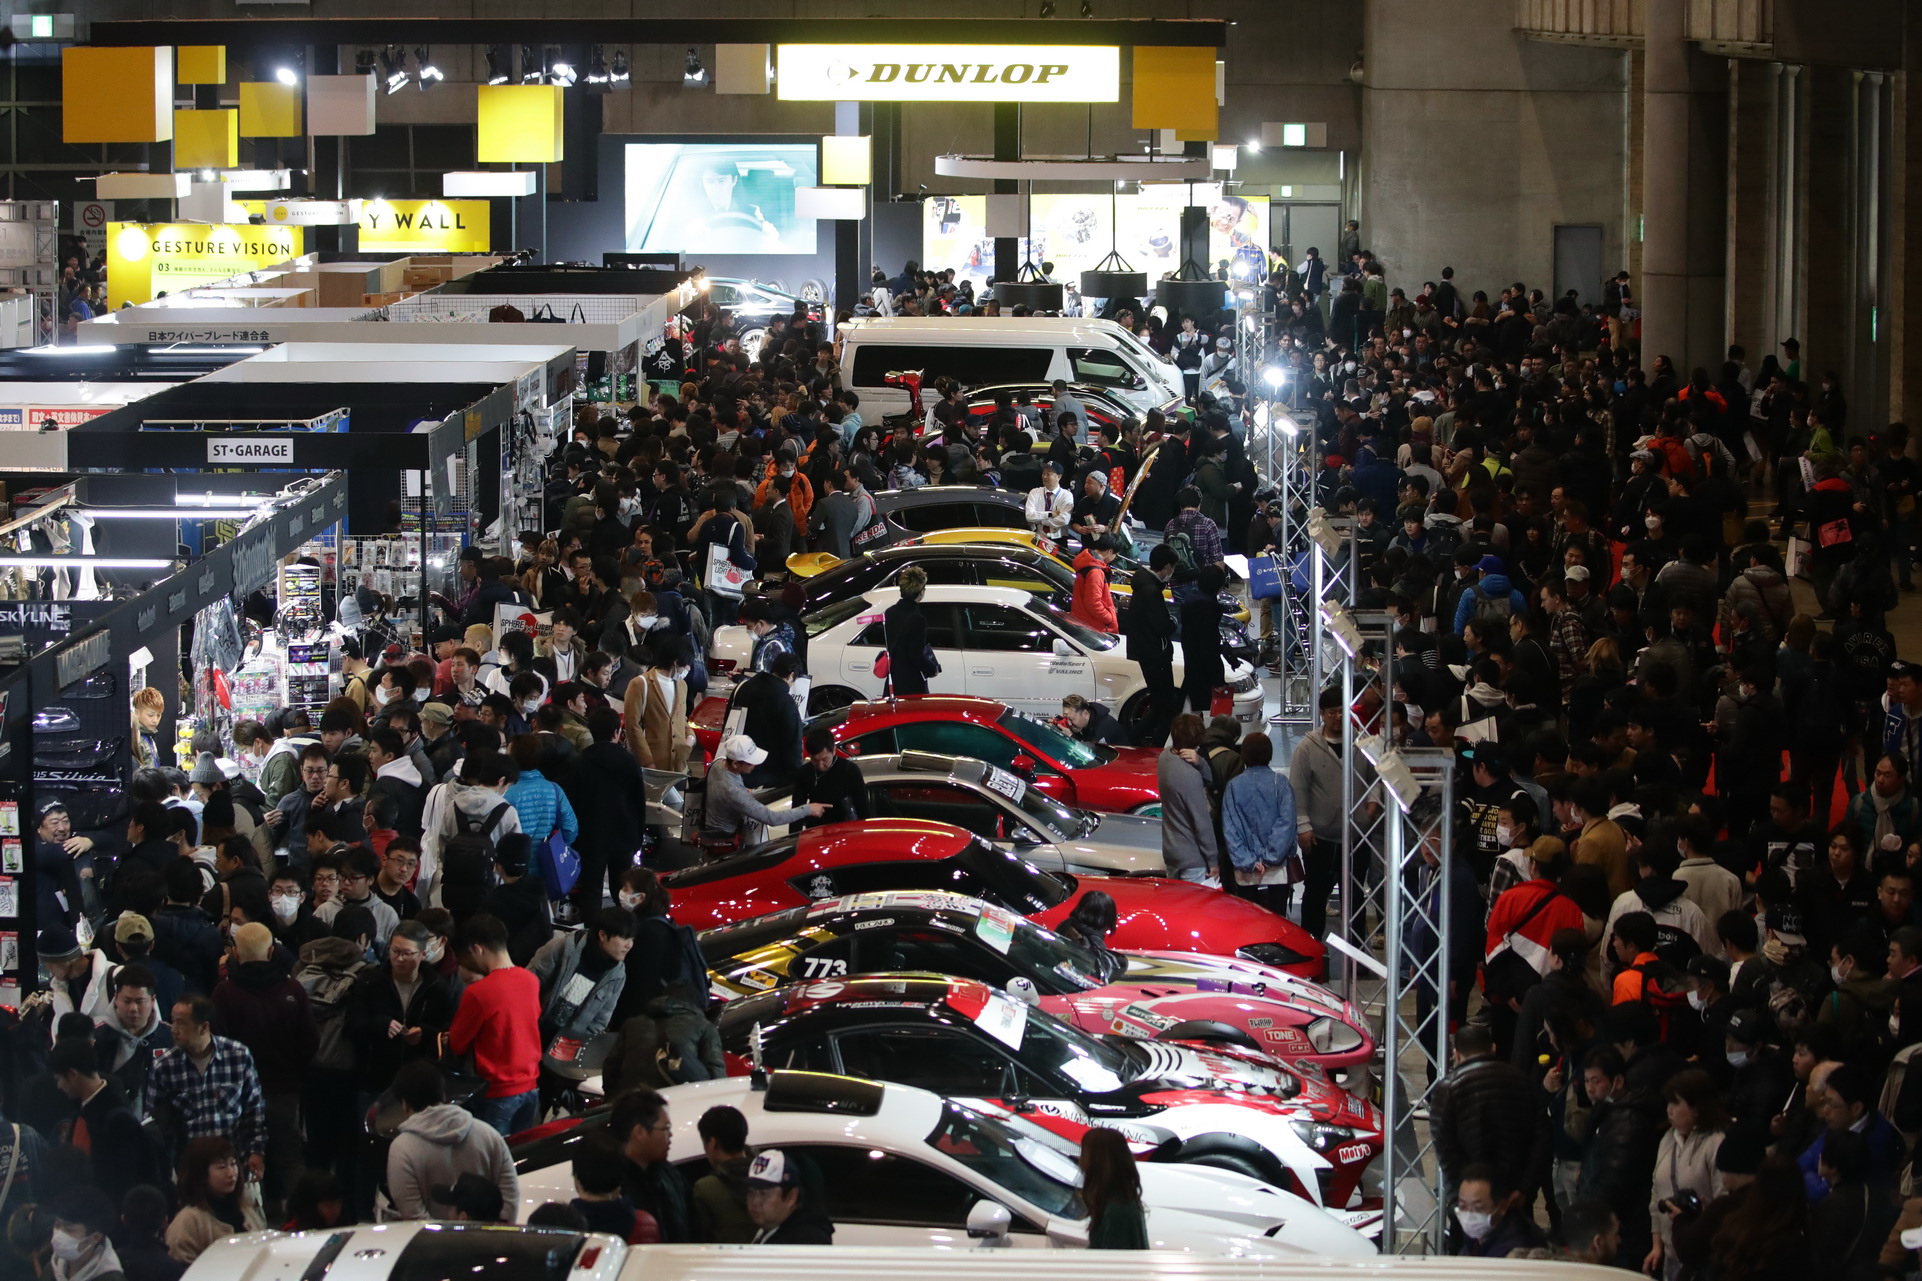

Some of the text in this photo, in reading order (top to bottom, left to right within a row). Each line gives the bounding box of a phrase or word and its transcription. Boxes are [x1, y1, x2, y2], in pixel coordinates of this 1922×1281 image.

[865, 63, 1069, 84] DUNLOP
[395, 213, 466, 229] WALL
[152, 240, 291, 256] GESTURE VISION
[148, 331, 269, 341] 日本ワイパーブレード連合会
[501, 619, 525, 629] SPHERE
[1844, 632, 1889, 656] AVIREX
[49, 771, 106, 781] Silvia
[855, 919, 893, 930] RECARO
[804, 957, 847, 978] 773
[1267, 1031, 1295, 1041] TONE
